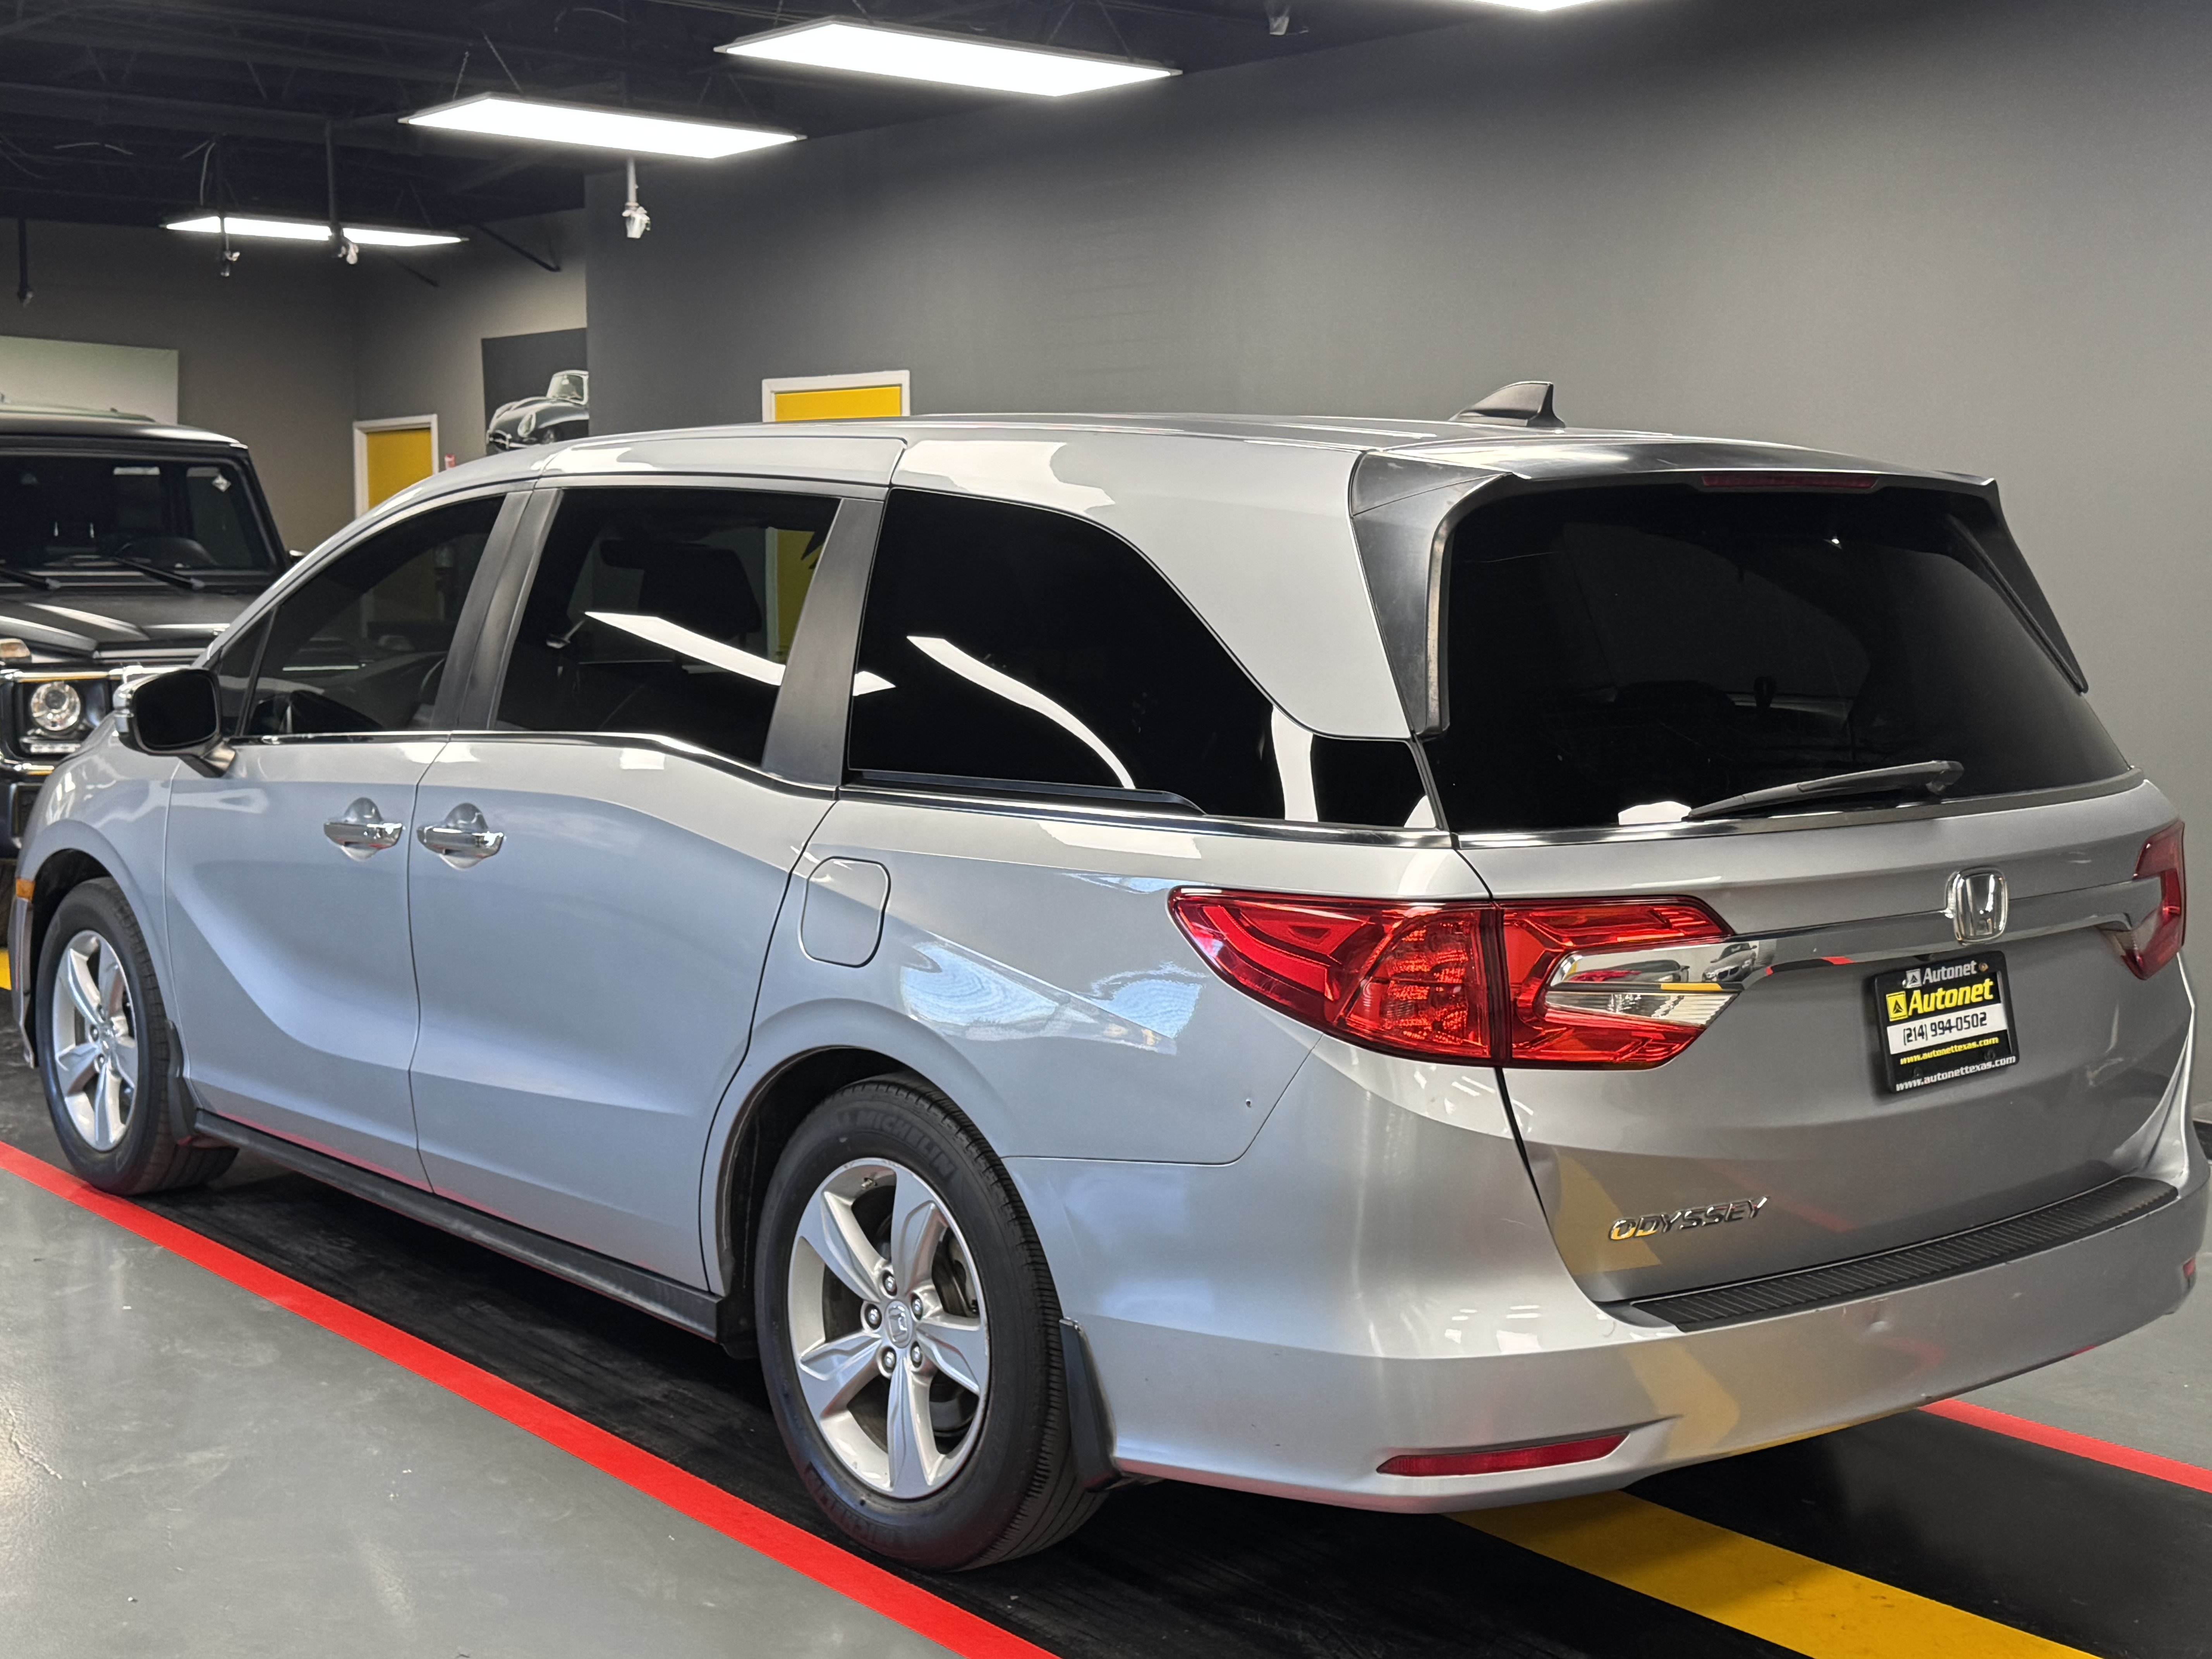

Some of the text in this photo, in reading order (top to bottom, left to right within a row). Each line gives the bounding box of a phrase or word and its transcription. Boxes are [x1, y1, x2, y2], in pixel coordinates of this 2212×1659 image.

[1923, 960, 1977, 984] Autonet
[1908, 978, 1994, 1016] Autonet
[1903, 1012, 1987, 1046] (214) 994-0502
[1900, 1037, 1999, 1065] www.autonettexas.com
[1896, 1056, 2016, 1091] www.autonettexas.com
[855, 1110, 958, 1179] MICHELIN
[1609, 1196, 1771, 1240] ODYSSEY
